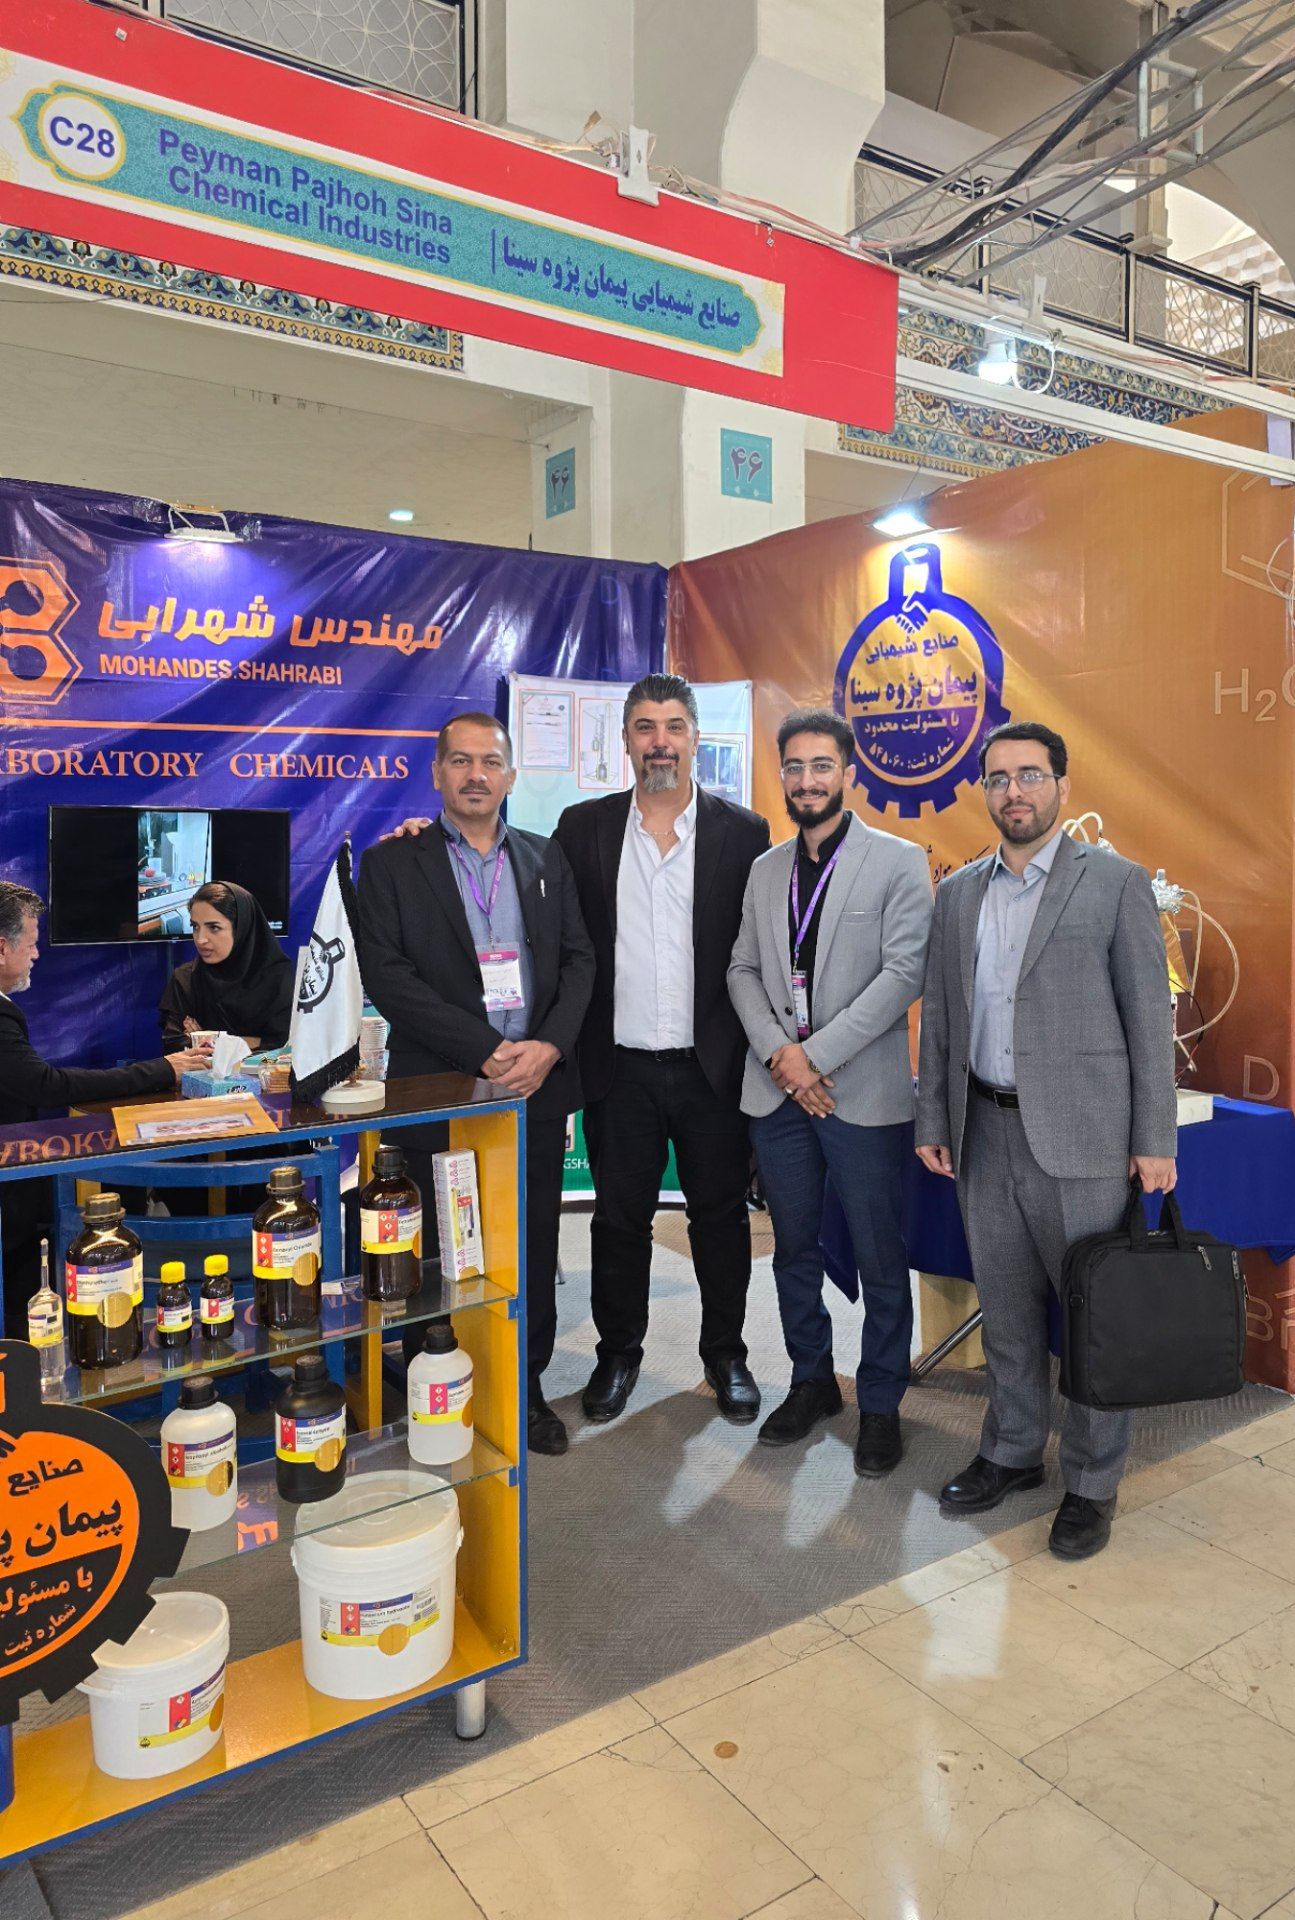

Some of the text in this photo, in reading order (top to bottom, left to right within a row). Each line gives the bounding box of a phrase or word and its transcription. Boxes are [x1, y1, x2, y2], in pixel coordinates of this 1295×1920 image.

[49, 115, 117, 159] C28
[159, 129, 452, 236] Peyman Pajhoh Sina
[168, 165, 451, 264] Chemical Industries
[503, 236, 741, 329] صنایع شیمیایی پیمان پژوه سینا
[729, 446, 764, 484] ۴۶
[98, 595, 444, 656] مهندس شهرابی
[866, 632, 959, 665] صنایع شیمیایی
[850, 664, 978, 711] پیمان پژوه سینا
[864, 722, 899, 738] محدود
[0, 747, 409, 780] BORATORY CHEMICALS
[8, 1455, 84, 1497] صنایع
[25, 1498, 124, 1557] پیمان
[76, 1566, 93, 1592] با
[35, 1603, 77, 1639] شماره
